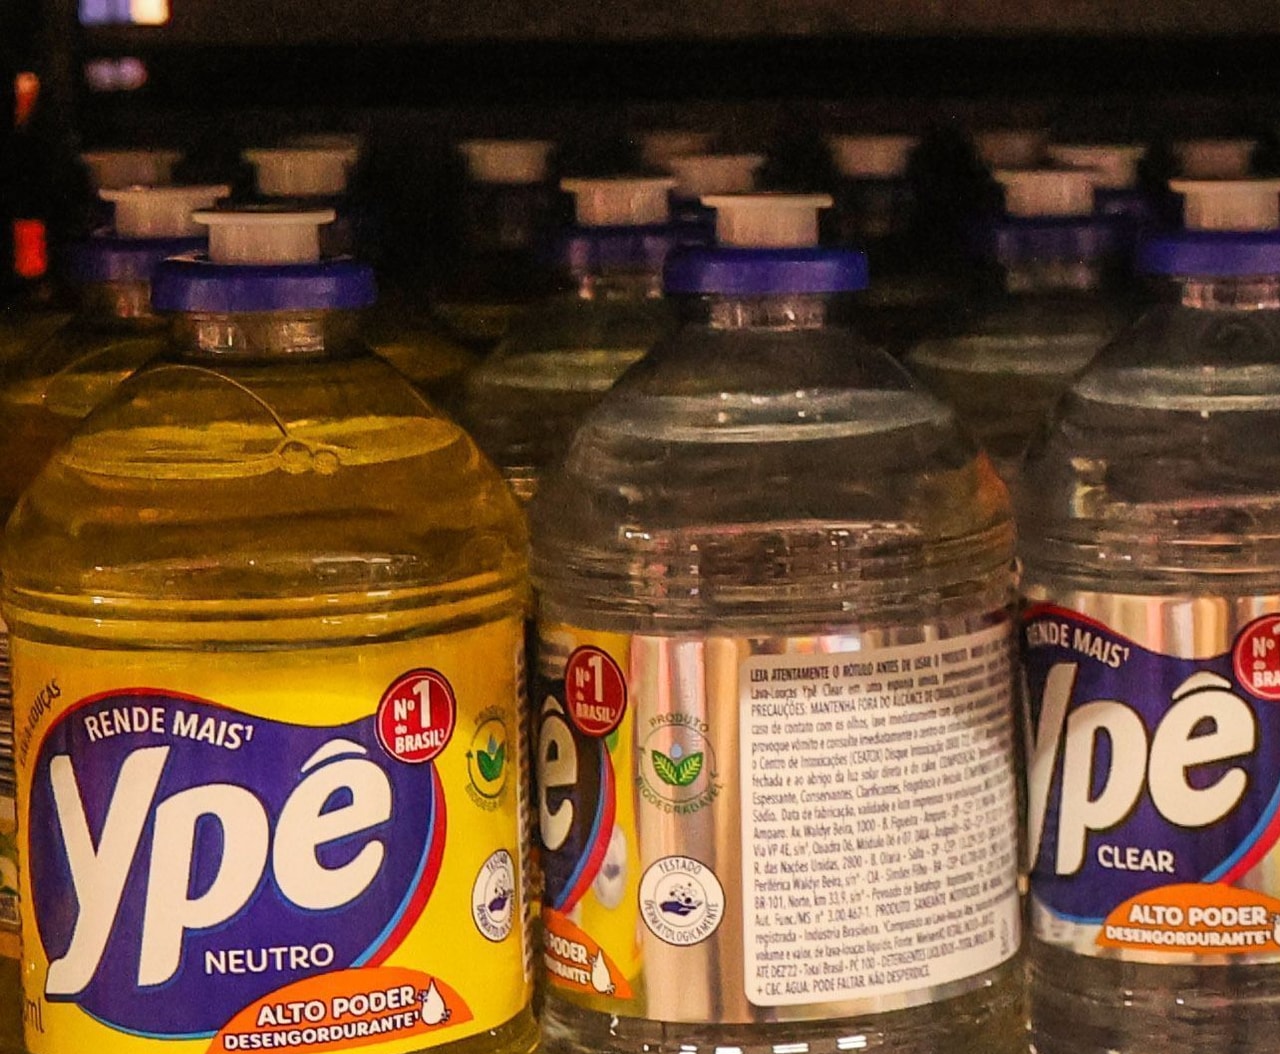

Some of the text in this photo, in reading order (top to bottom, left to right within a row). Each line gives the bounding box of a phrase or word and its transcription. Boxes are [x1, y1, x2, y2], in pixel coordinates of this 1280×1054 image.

[750, 668, 768, 682] LEIA
[771, 666, 830, 682] ATENTAMENTE
[413, 679, 431, 729] 1
[84, 707, 166, 743] RENDE
[648, 713, 710, 733] PRODUTO
[45, 738, 393, 997] Ypê
[658, 858, 703, 876] TESTADO
[1097, 843, 1175, 873] CLEAR
[1129, 903, 1268, 927] ALTO PODER
[204, 942, 335, 975] NEUTRO
[256, 985, 415, 1029] ALTO PODER
